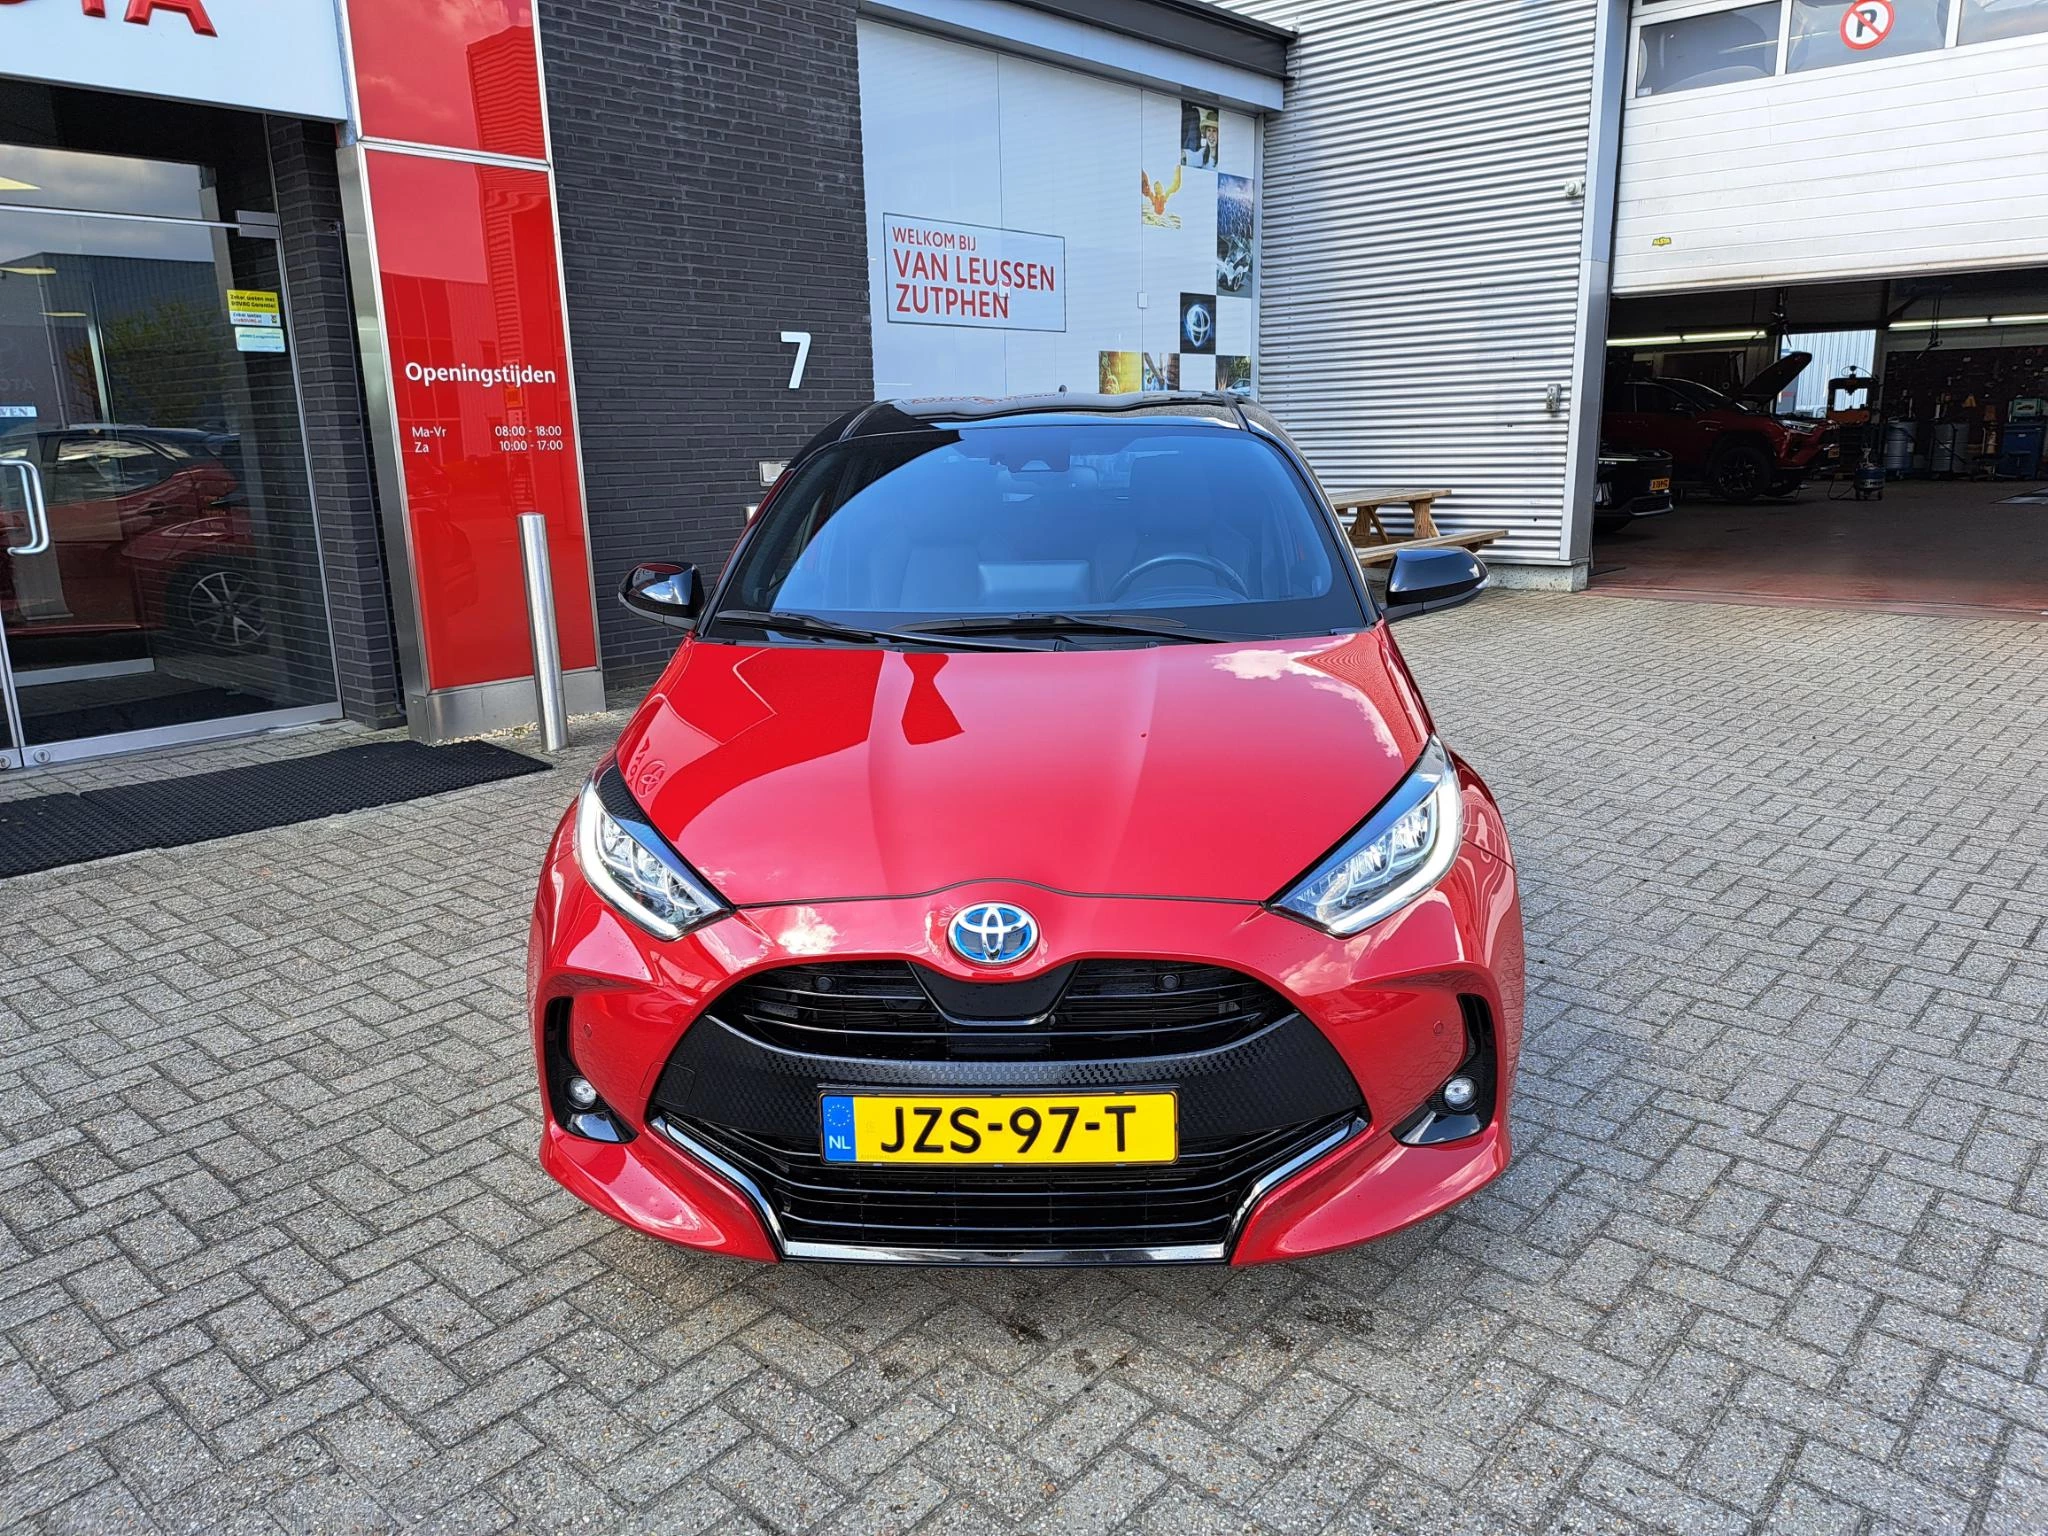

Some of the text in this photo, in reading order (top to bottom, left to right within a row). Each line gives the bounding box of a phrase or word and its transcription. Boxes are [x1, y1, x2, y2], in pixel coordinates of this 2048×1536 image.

[1856, 9, 1877, 38] P
[892, 226, 977, 251] WELKOM BIJ
[893, 249, 1055, 292] VAN LEUSSEN
[896, 283, 1009, 319] ZUTPHEN
[781, 331, 812, 389] 7
[405, 362, 556, 388] Openingstijden
[411, 426, 447, 438] Ma-Vr
[495, 425, 526, 437] 08:00
[536, 425, 562, 436] 18:00
[414, 441, 430, 453] Za
[500, 440, 527, 451] 10:00
[537, 440, 563, 451] 17:00
[880, 1105, 1137, 1153] JZS-97-T
[829, 1136, 851, 1150] NL
